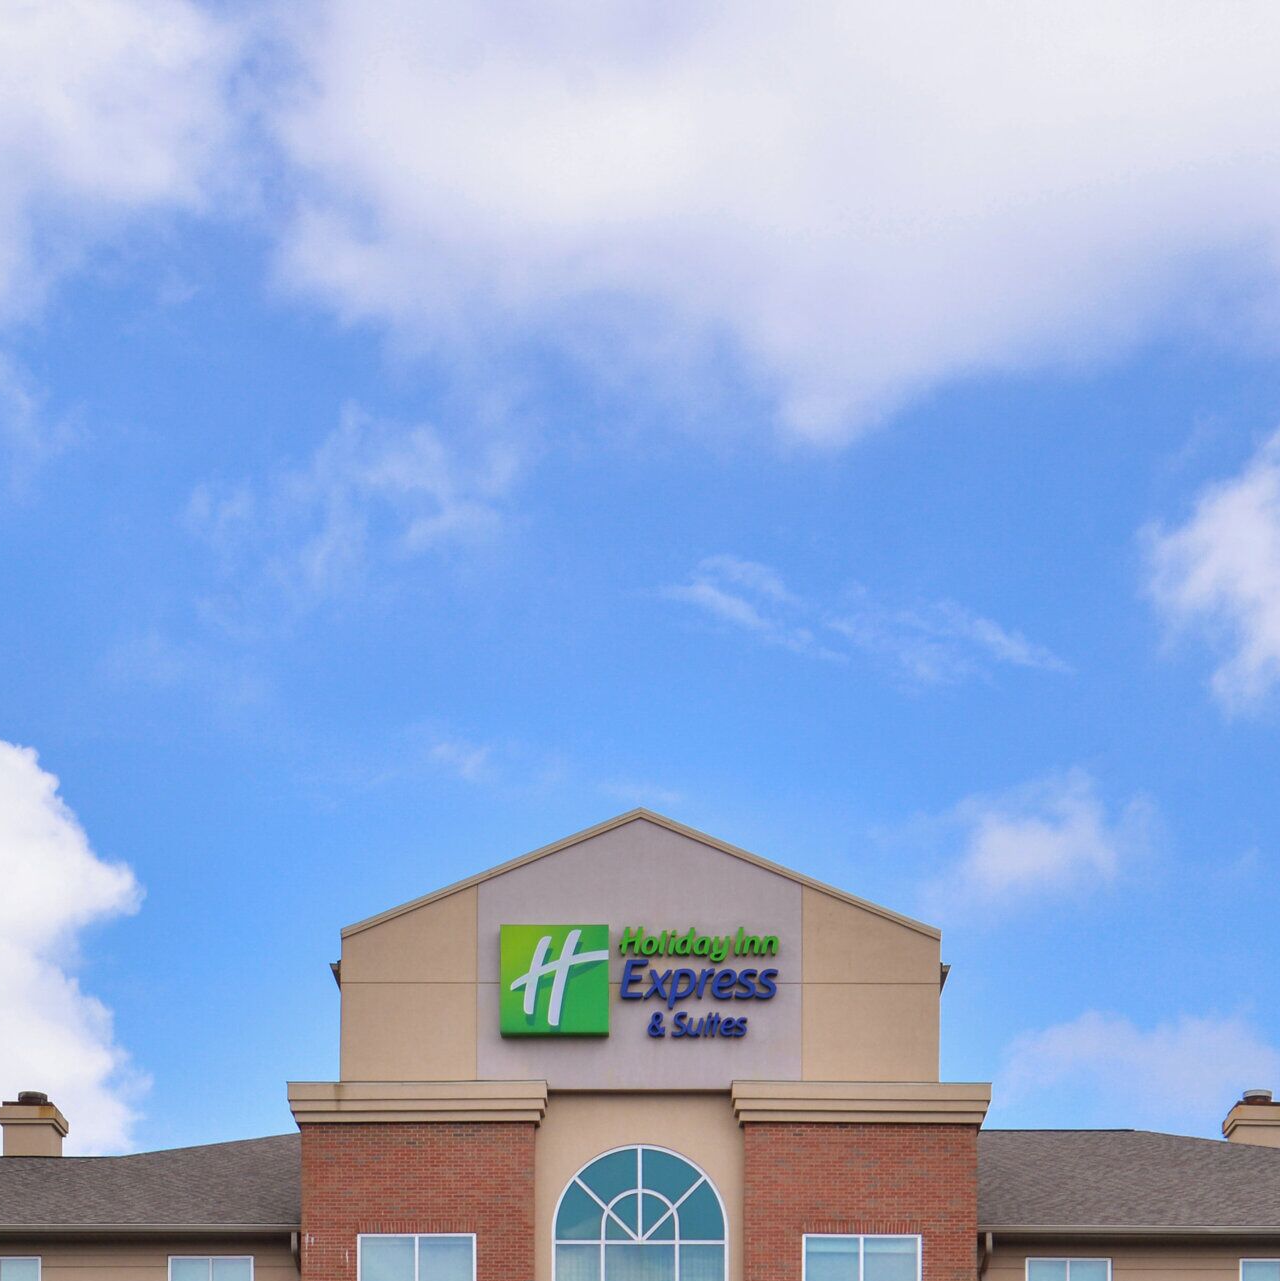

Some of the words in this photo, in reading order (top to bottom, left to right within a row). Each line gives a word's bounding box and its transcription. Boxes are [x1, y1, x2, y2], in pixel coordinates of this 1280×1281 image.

[620, 927, 730, 962] Holiday
[734, 927, 779, 956] Inn
[620, 959, 778, 1010] Express
[647, 1011, 666, 1037] &
[671, 1011, 748, 1038] Suites
